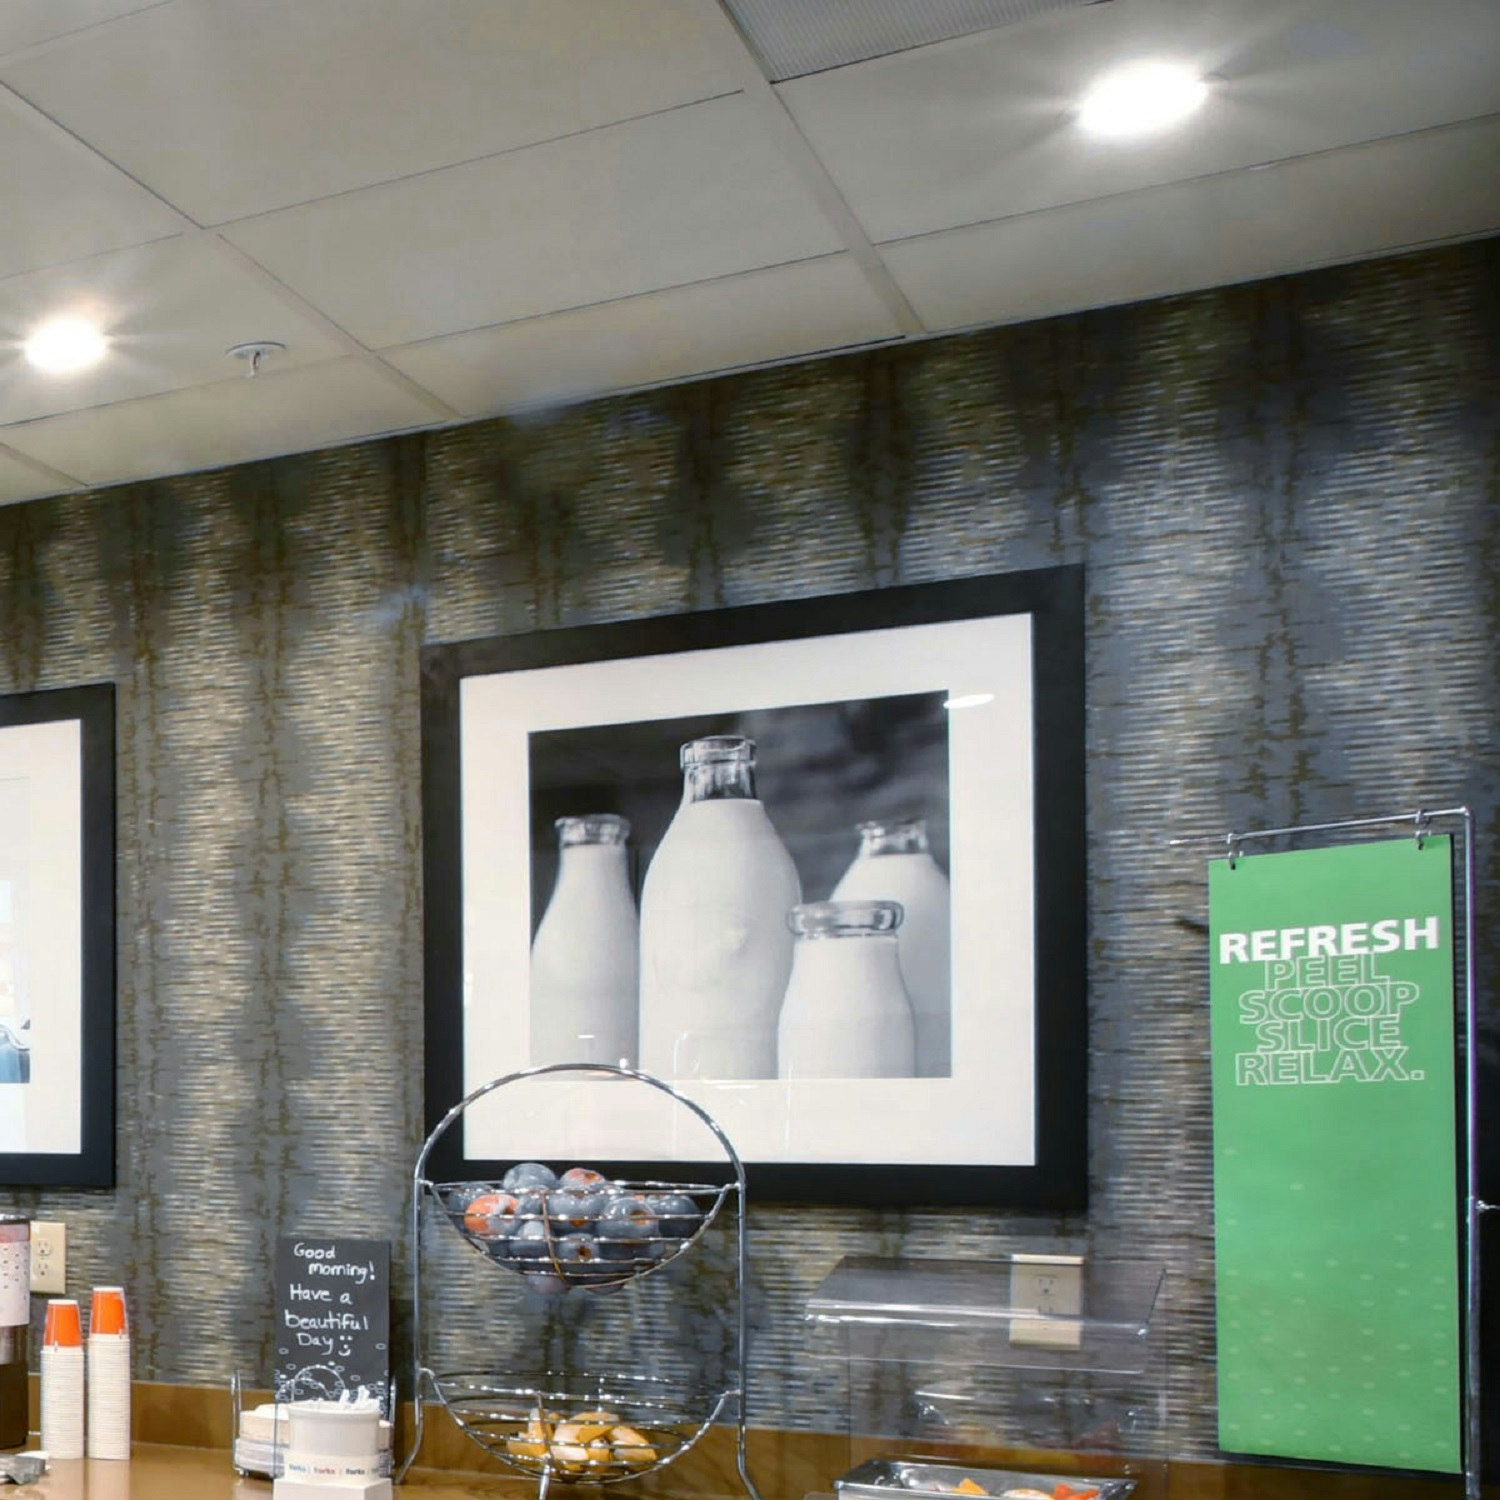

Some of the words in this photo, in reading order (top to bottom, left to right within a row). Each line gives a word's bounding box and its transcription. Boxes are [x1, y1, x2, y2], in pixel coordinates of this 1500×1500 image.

[1219, 916, 1439, 964] REFRESH
[1265, 952, 1391, 991] PEEL
[1239, 981, 1421, 1024] SCOOP
[1255, 1014, 1402, 1053] SLICE
[1236, 1046, 1426, 1086] RELAX.
[294, 1242, 336, 1259] Good
[289, 1283, 333, 1302] Have
[340, 1292, 354, 1305] a
[284, 1309, 369, 1330] beautiful
[296, 1332, 334, 1355] Day
